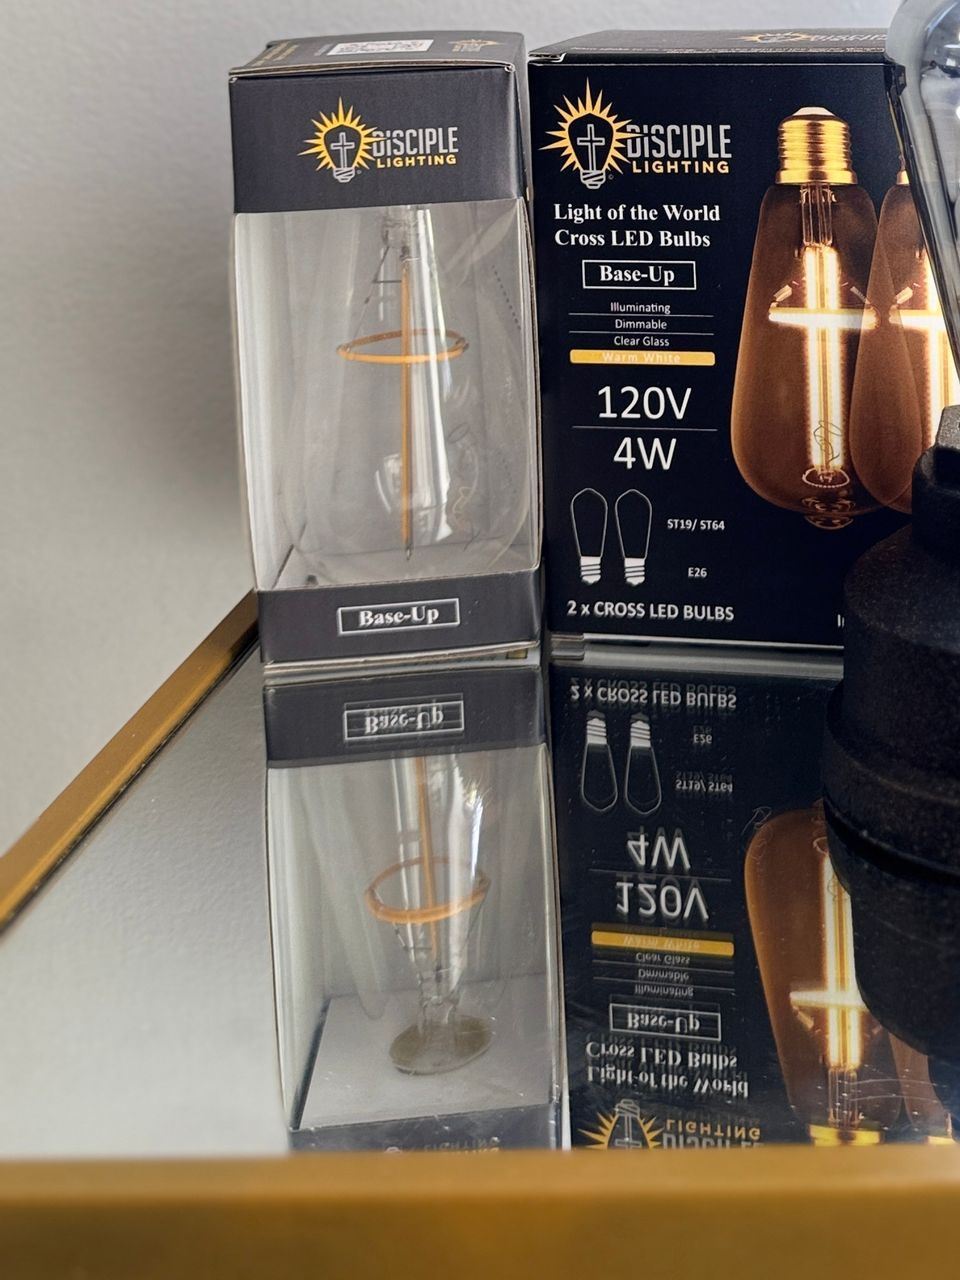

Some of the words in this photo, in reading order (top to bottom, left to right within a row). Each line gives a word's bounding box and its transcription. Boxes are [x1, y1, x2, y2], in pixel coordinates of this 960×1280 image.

[377, 154, 456, 169] LIGHTING
[632, 161, 730, 174] LIGHTING
[553, 204, 602, 224] Light
[607, 204, 627, 220] of
[630, 204, 658, 221] the
[663, 204, 721, 221] World
[555, 229, 605, 246] Cross
[611, 230, 653, 246] LED
[659, 230, 711, 247] Bulbs
[600, 265, 675, 286] Base-Up
[610, 302, 671, 314] Illuminating
[615, 318, 667, 330] Dimmable
[613, 336, 641, 347] Clear
[643, 336, 670, 348] Glass
[602, 351, 639, 363] Warm
[643, 353, 681, 364] White
[597, 386, 692, 421] 120V
[613, 437, 677, 470] 4W
[688, 567, 708, 578] E26
[359, 606, 439, 627] Base-Up
[567, 601, 577, 616] 2
[593, 602, 646, 618] CROSS
[649, 603, 679, 618] LED
[683, 604, 735, 621] BULBS
